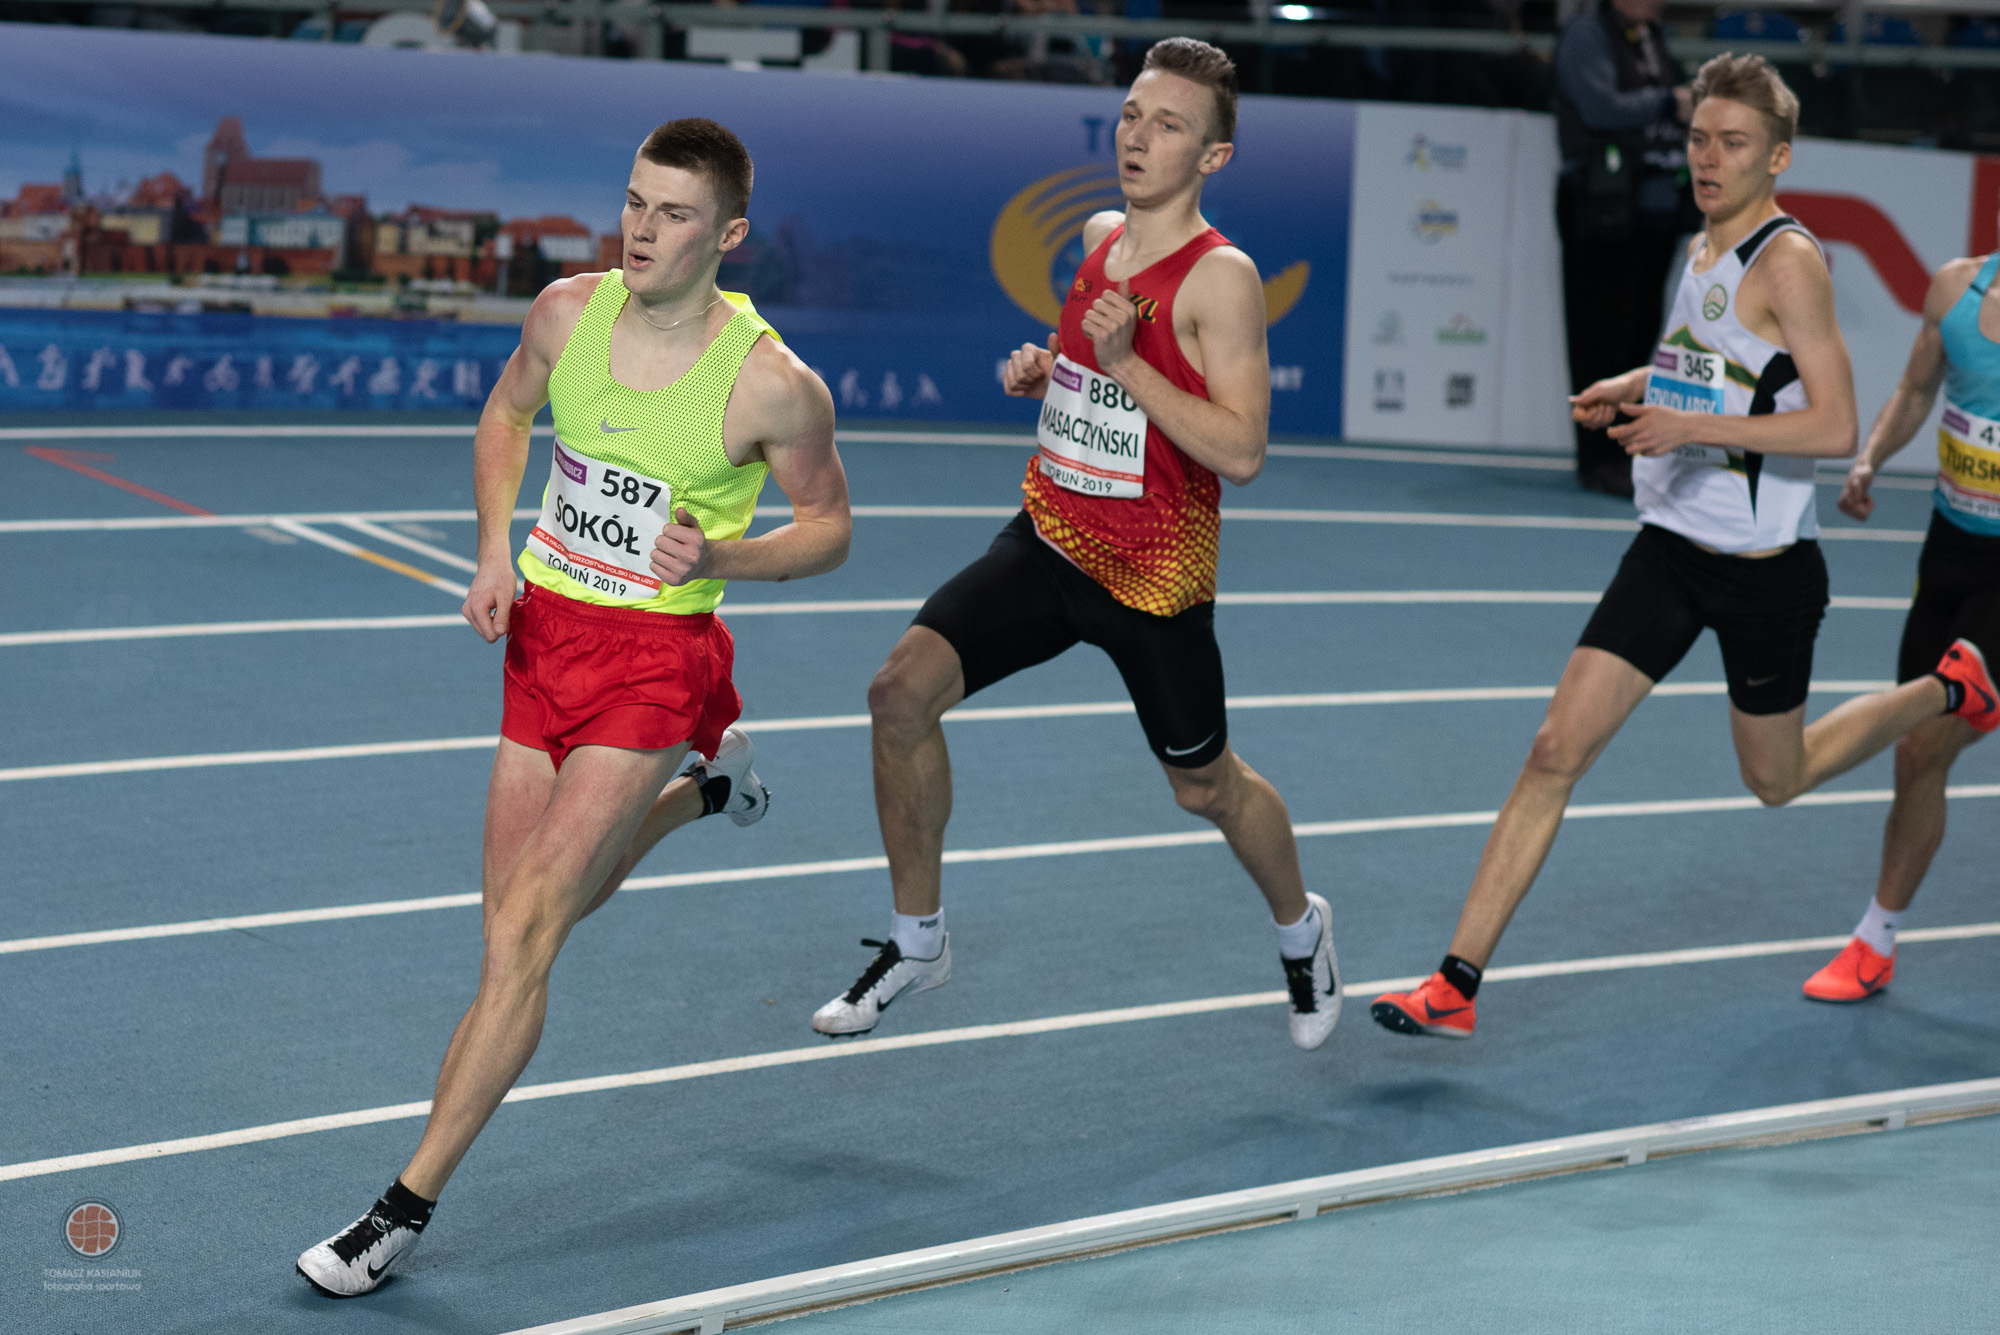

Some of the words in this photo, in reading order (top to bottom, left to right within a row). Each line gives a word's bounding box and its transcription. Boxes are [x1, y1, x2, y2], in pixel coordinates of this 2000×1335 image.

[1684, 353, 1714, 382] 345
[1041, 402, 1139, 458] MASACZYŃSKI
[1979, 426, 2000, 446] 4
[600, 468, 662, 508] 587
[1047, 463, 1079, 486] TORUŃ
[1082, 477, 1112, 493] 2019
[555, 494, 641, 556] SOKÓŁ
[547, 553, 590, 585] TORUŃ
[592, 575, 627, 597] 2019
[605, 566, 628, 578] POLSKI
